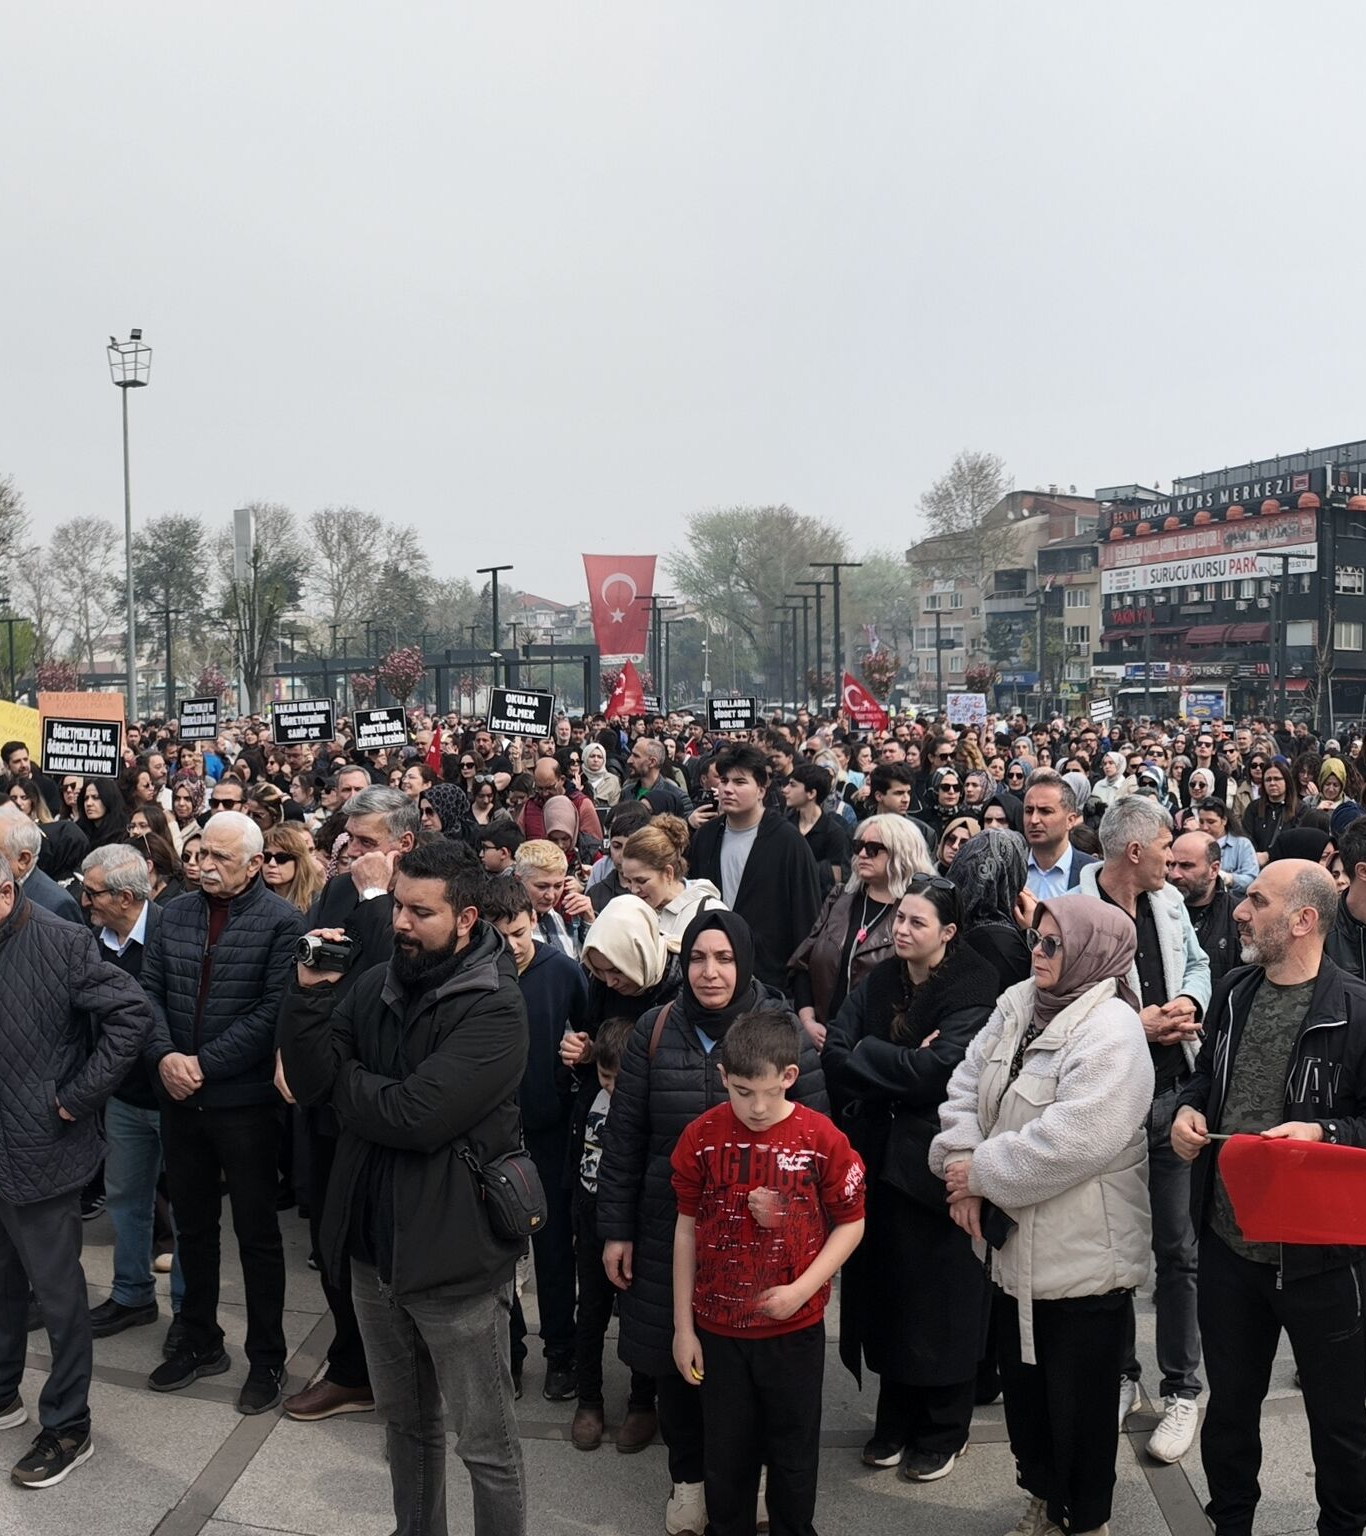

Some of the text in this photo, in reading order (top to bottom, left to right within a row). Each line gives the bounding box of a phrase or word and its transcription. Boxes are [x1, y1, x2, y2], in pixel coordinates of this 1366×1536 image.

[1140, 501, 1171, 520] HOCAM
[1177, 493, 1213, 512] KURS
[1219, 479, 1291, 504] MERKEZİ
[1150, 564, 1189, 585] SÜRÜCÜ
[1191, 557, 1226, 580] KURSU
[1229, 555, 1258, 575] PARK
[505, 693, 539, 708] OKULDA
[713, 699, 751, 709] OKULLARDA
[274, 703, 298, 714] BAKAN
[506, 706, 536, 720] ÖLMEK
[714, 708, 750, 720] ŞİDDET SON
[491, 716, 547, 735] İSTEMİYORUZ
[720, 720, 745, 729] BULSUN
[52, 723, 112, 743] ÖĞRETMENLER VE
[287, 727, 321, 739] SAHİP ÇIK
[46, 738, 116, 758] ÖĞRENCİLER ÖLÜYOR
[49, 757, 112, 774] BAKANLIK UYUYOR
